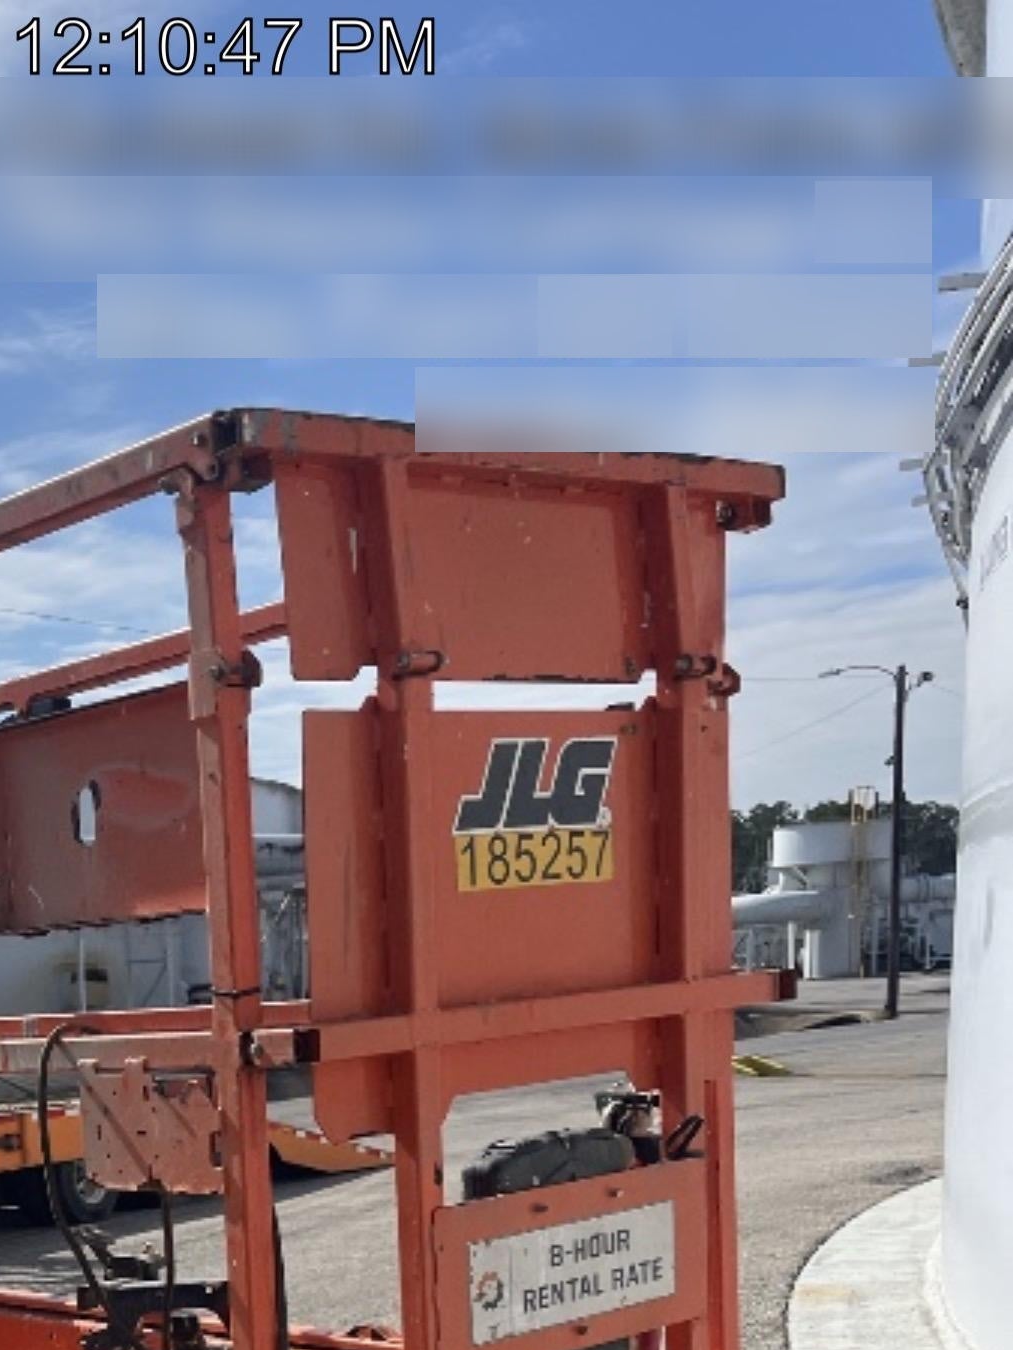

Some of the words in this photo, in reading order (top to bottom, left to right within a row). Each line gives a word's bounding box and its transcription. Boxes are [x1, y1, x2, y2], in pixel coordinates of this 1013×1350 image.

[453, 736, 618, 834] JLG
[461, 831, 609, 887] 185257
[523, 1273, 604, 1313] RENTAL
[611, 1256, 663, 1291] RATE
